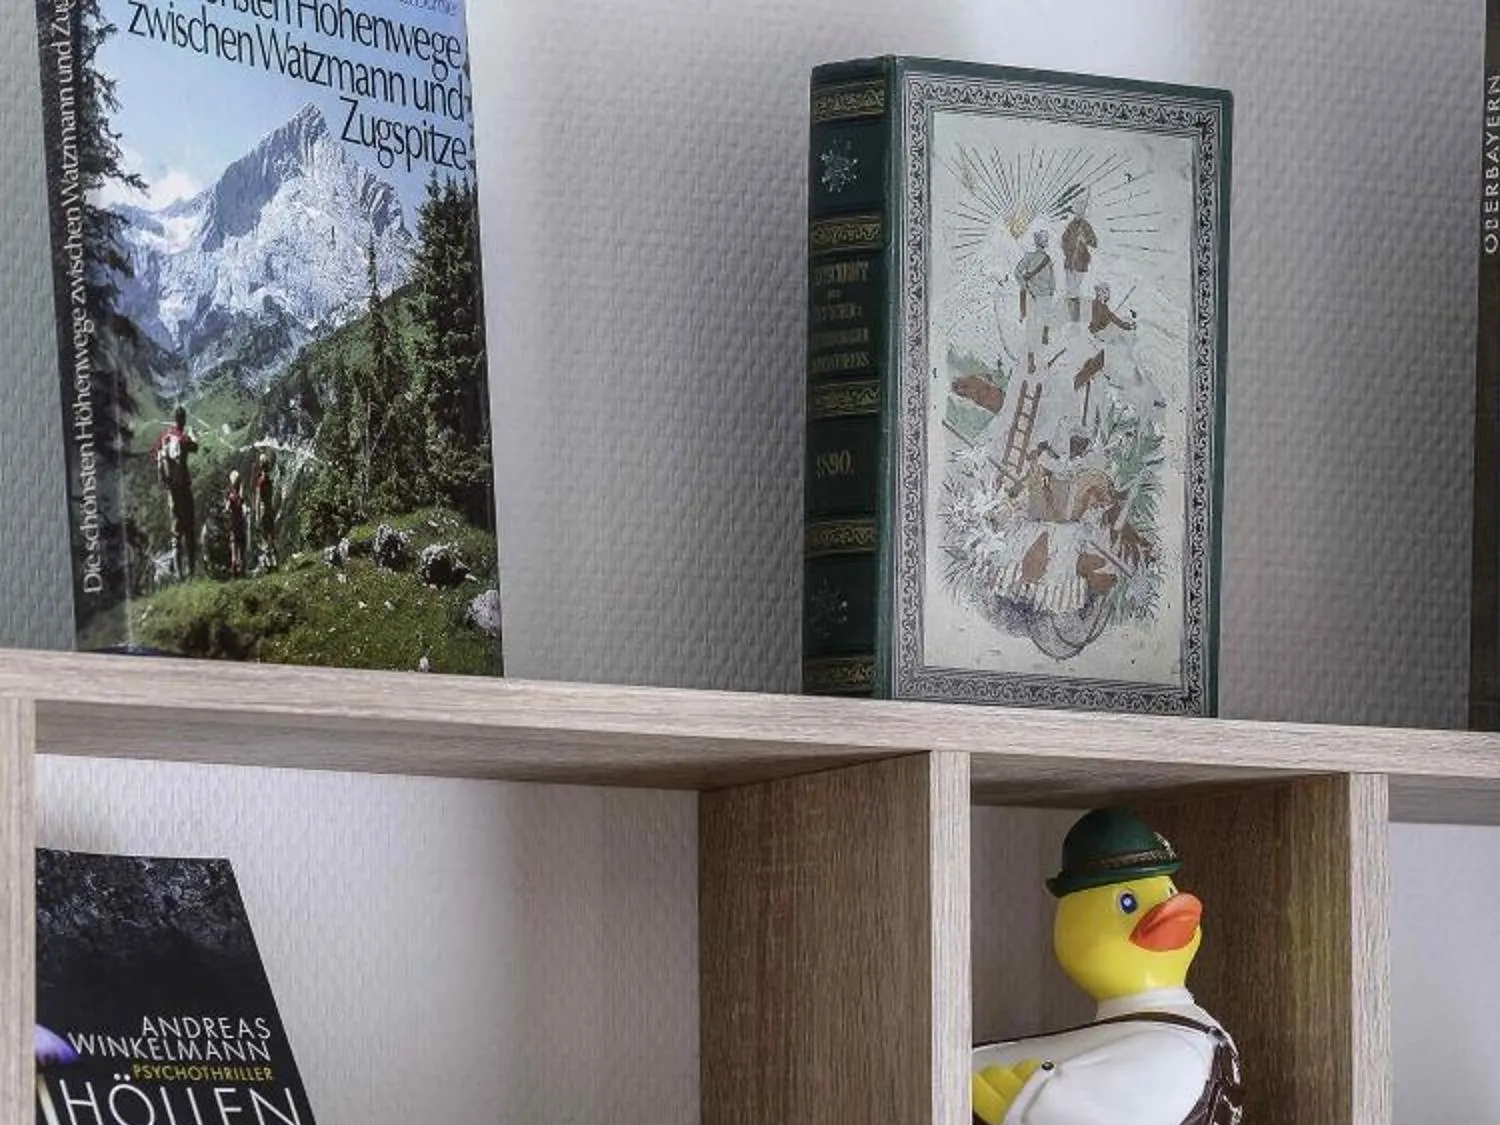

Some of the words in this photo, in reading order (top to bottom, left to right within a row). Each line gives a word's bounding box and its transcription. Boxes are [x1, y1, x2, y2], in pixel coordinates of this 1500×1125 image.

[50, 41, 74, 84] und
[255, 23, 408, 108] Watzmann
[412, 74, 466, 122] und
[58, 89, 81, 207] Watzmann
[339, 96, 468, 173] Zugspitze
[63, 205, 88, 305] zwischen
[71, 306, 96, 440] Höhenwege
[79, 441, 100, 551] schönsten
[83, 554, 102, 593] Die
[67, 1031, 272, 1062] WINKELMANN
[141, 1015, 272, 1041] ANDREAS
[132, 1063, 274, 1082] PSYCHOTHRILLER
